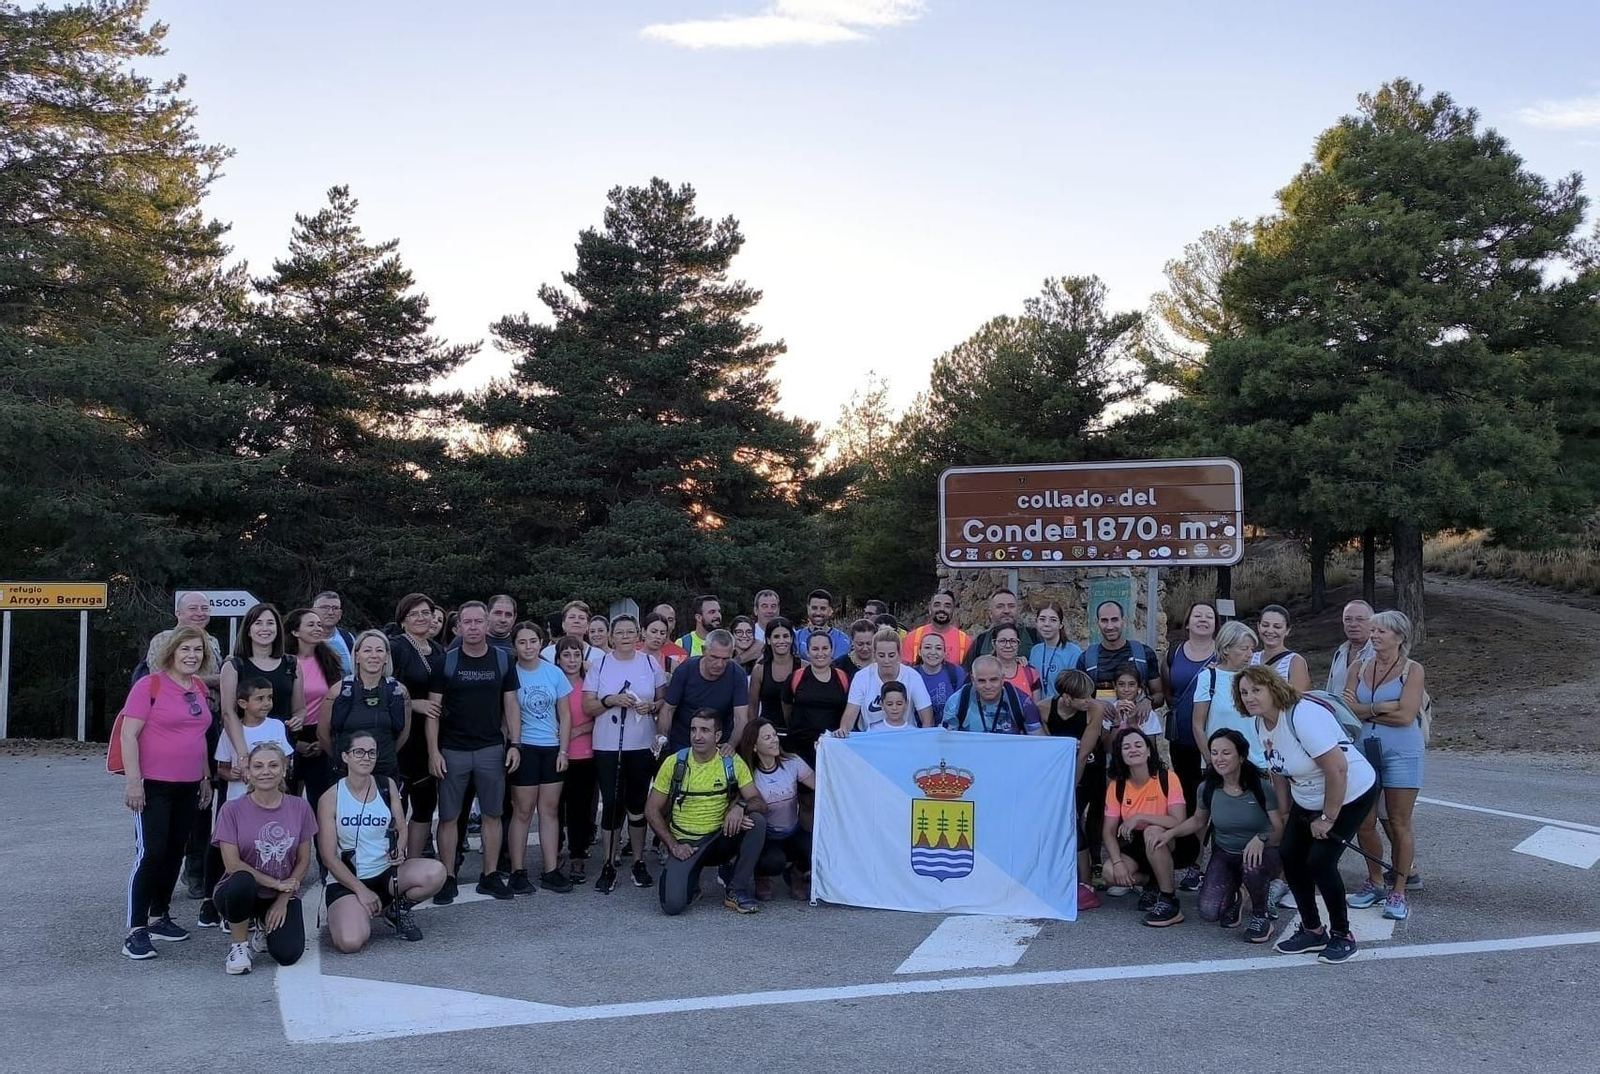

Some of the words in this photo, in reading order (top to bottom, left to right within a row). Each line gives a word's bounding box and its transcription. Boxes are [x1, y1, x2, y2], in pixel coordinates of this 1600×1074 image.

[1017, 489, 1104, 509] collado
[1119, 488, 1157, 506] del
[963, 518, 1062, 543] Conde
[1082, 516, 1158, 541] 1870
[9, 586, 42, 594] refugio
[9, 595, 50, 606] Arroyo
[56, 595, 103, 605] Berruga
[340, 814, 388, 827] adidas
